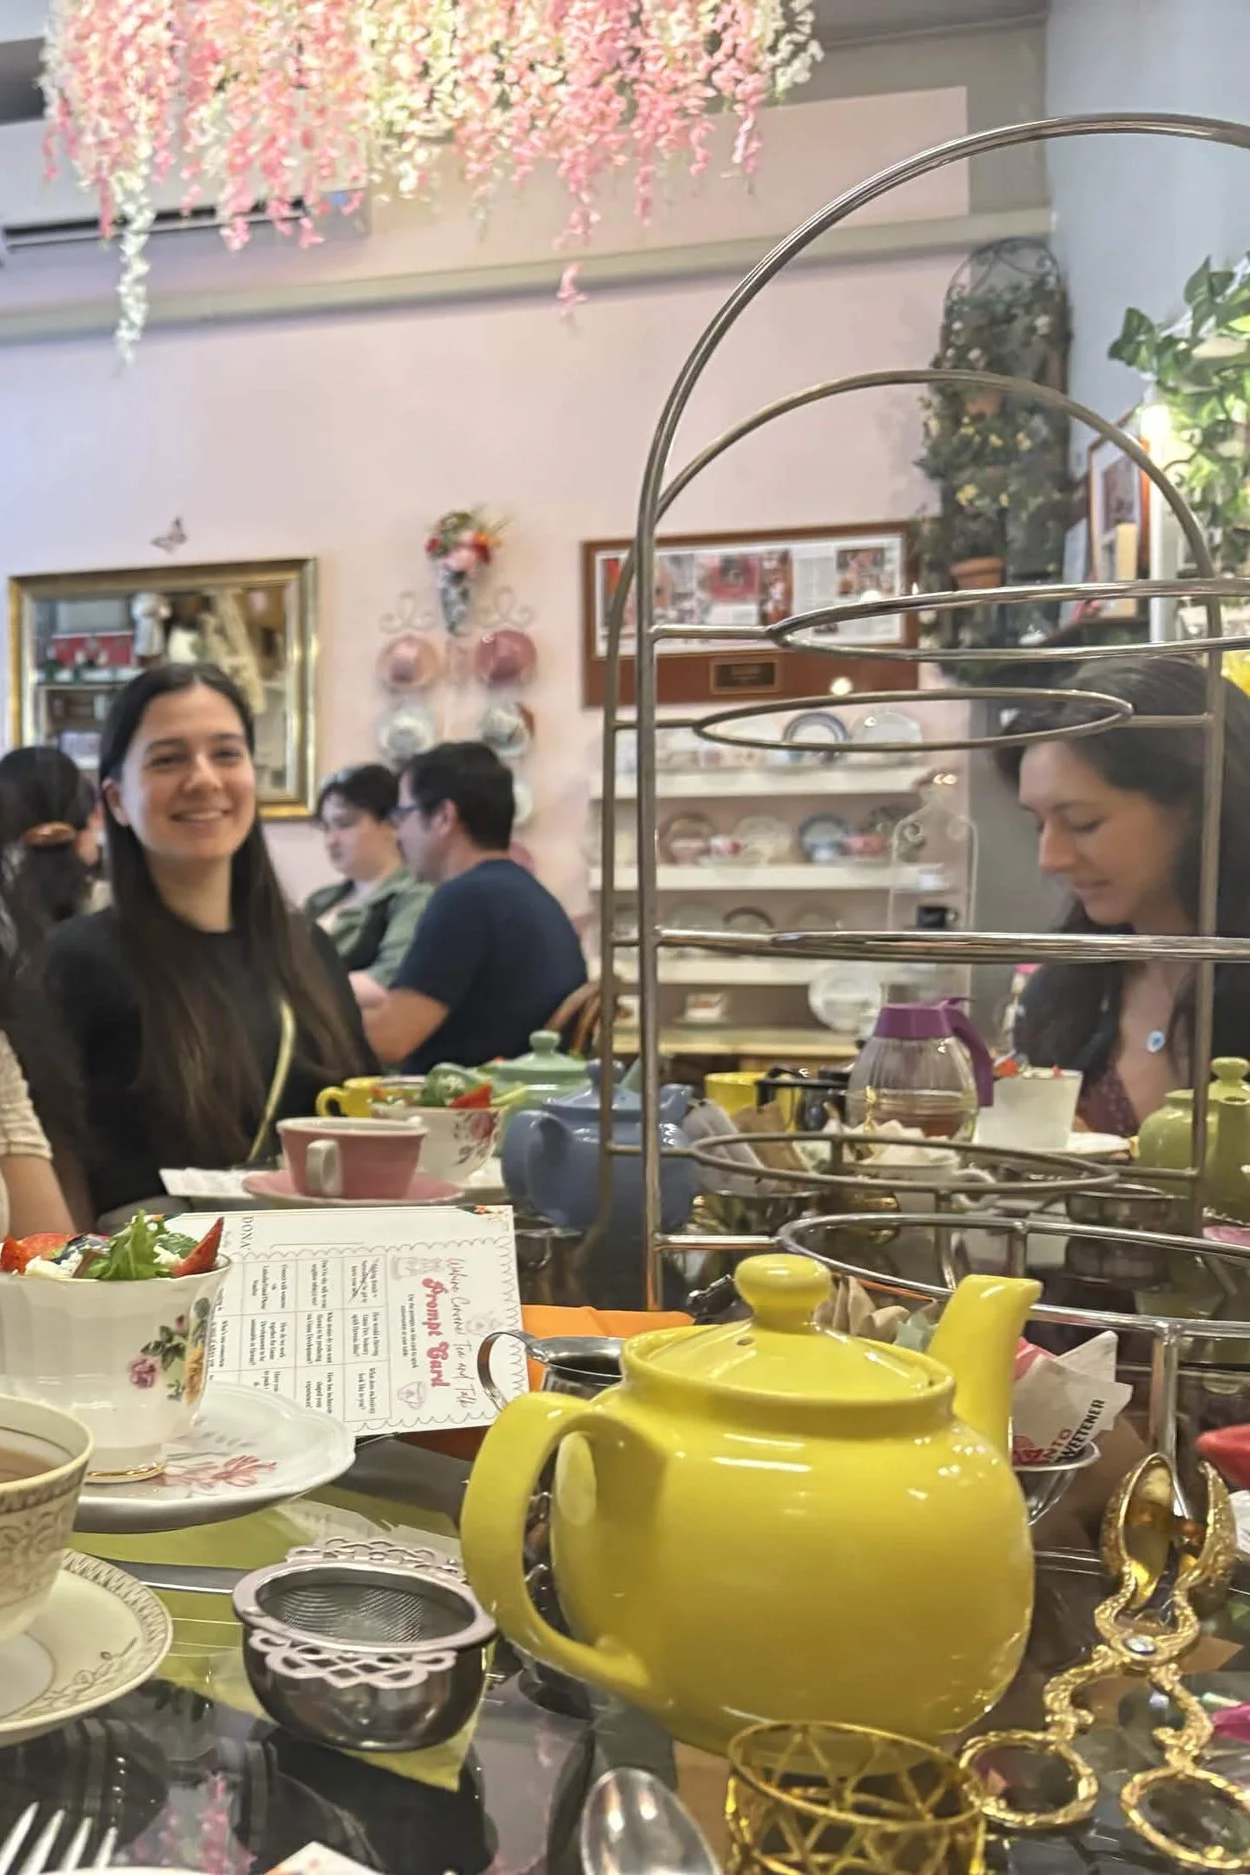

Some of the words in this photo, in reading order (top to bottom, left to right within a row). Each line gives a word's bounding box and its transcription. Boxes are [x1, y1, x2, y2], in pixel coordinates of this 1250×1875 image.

[241, 1216, 254, 1251] DONA
[422, 1278, 449, 1336] Prompt
[426, 1342, 450, 1387] Card
[454, 1340, 472, 1358] Tea
[452, 1362, 474, 1380] and
